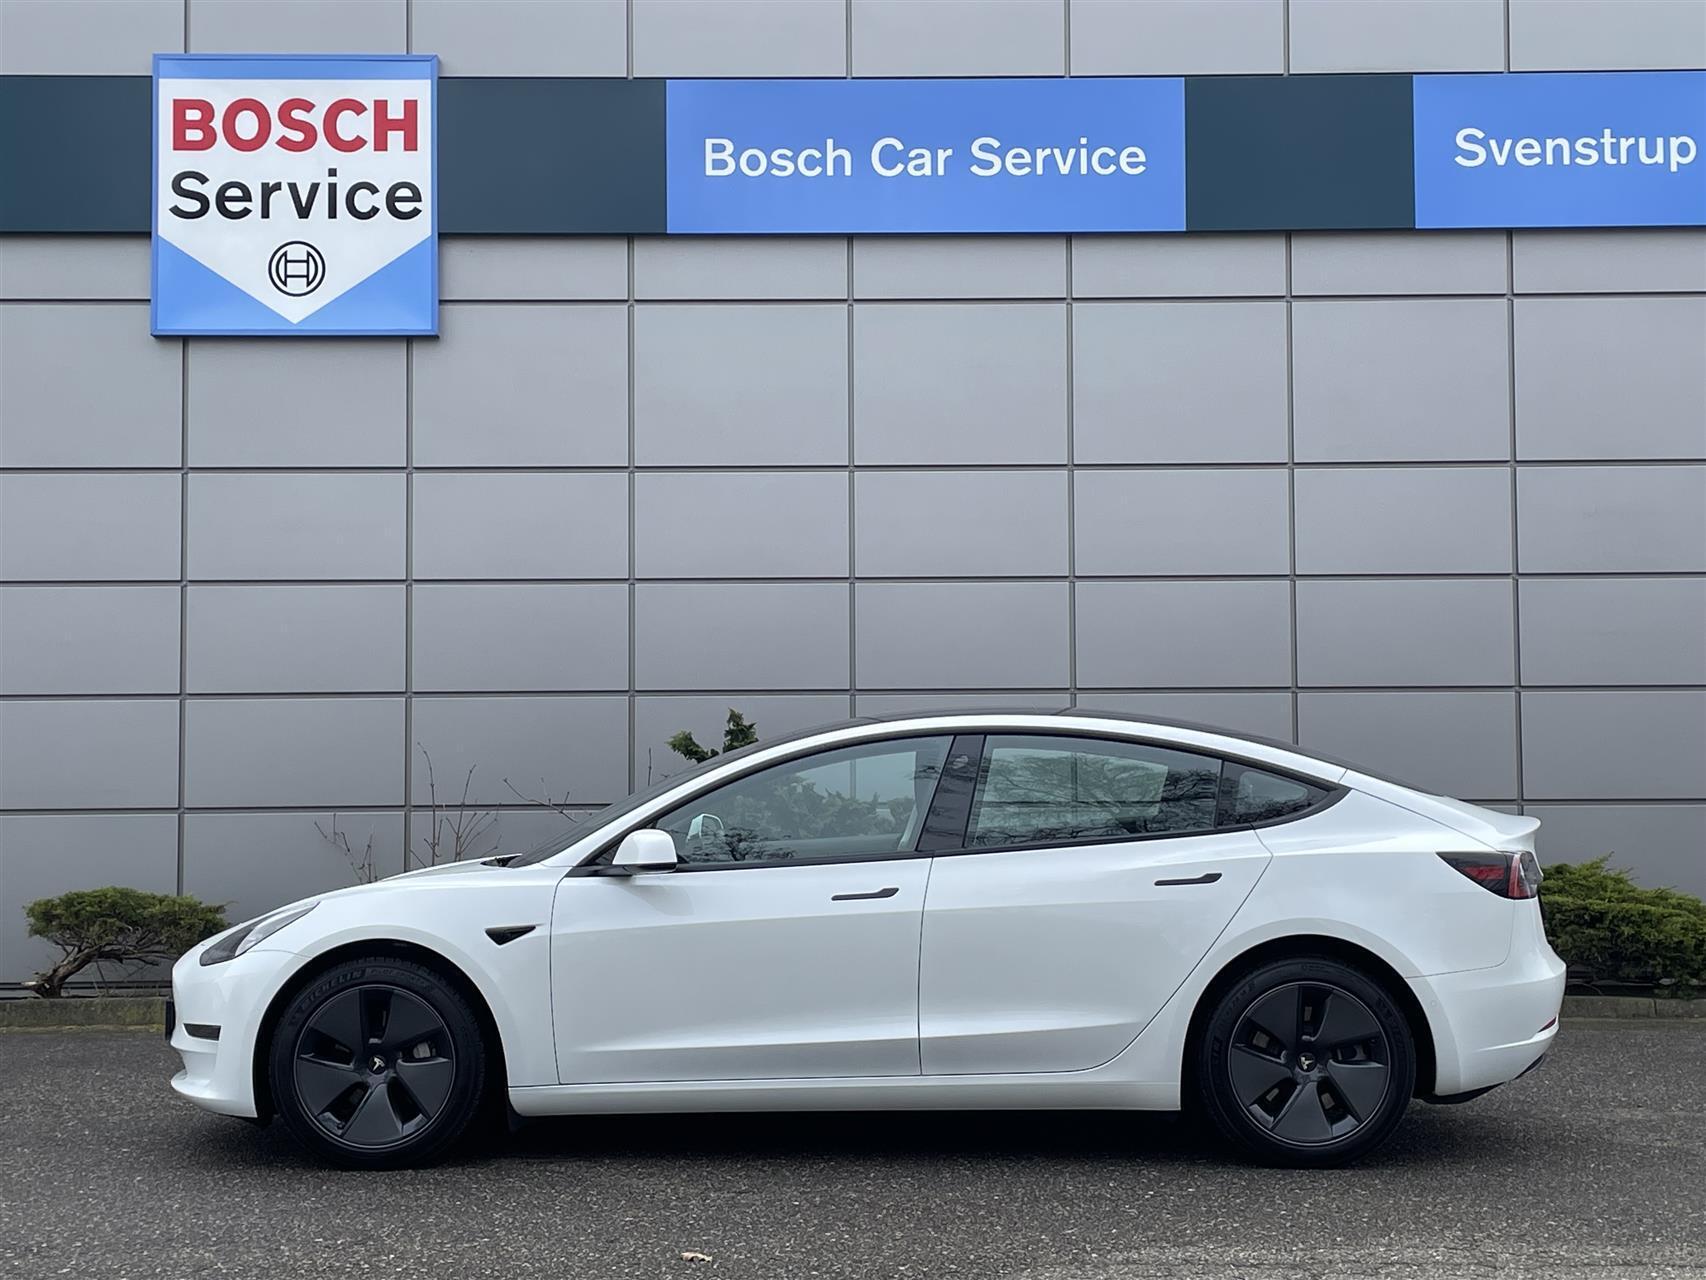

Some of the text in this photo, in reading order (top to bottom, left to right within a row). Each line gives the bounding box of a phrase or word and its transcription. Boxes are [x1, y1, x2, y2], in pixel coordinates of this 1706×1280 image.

[173, 98, 417, 153] BOSCH
[1454, 127, 1697, 172] Svenstrup
[704, 136, 1147, 177] Bosch Car Service
[168, 167, 423, 220] Service
